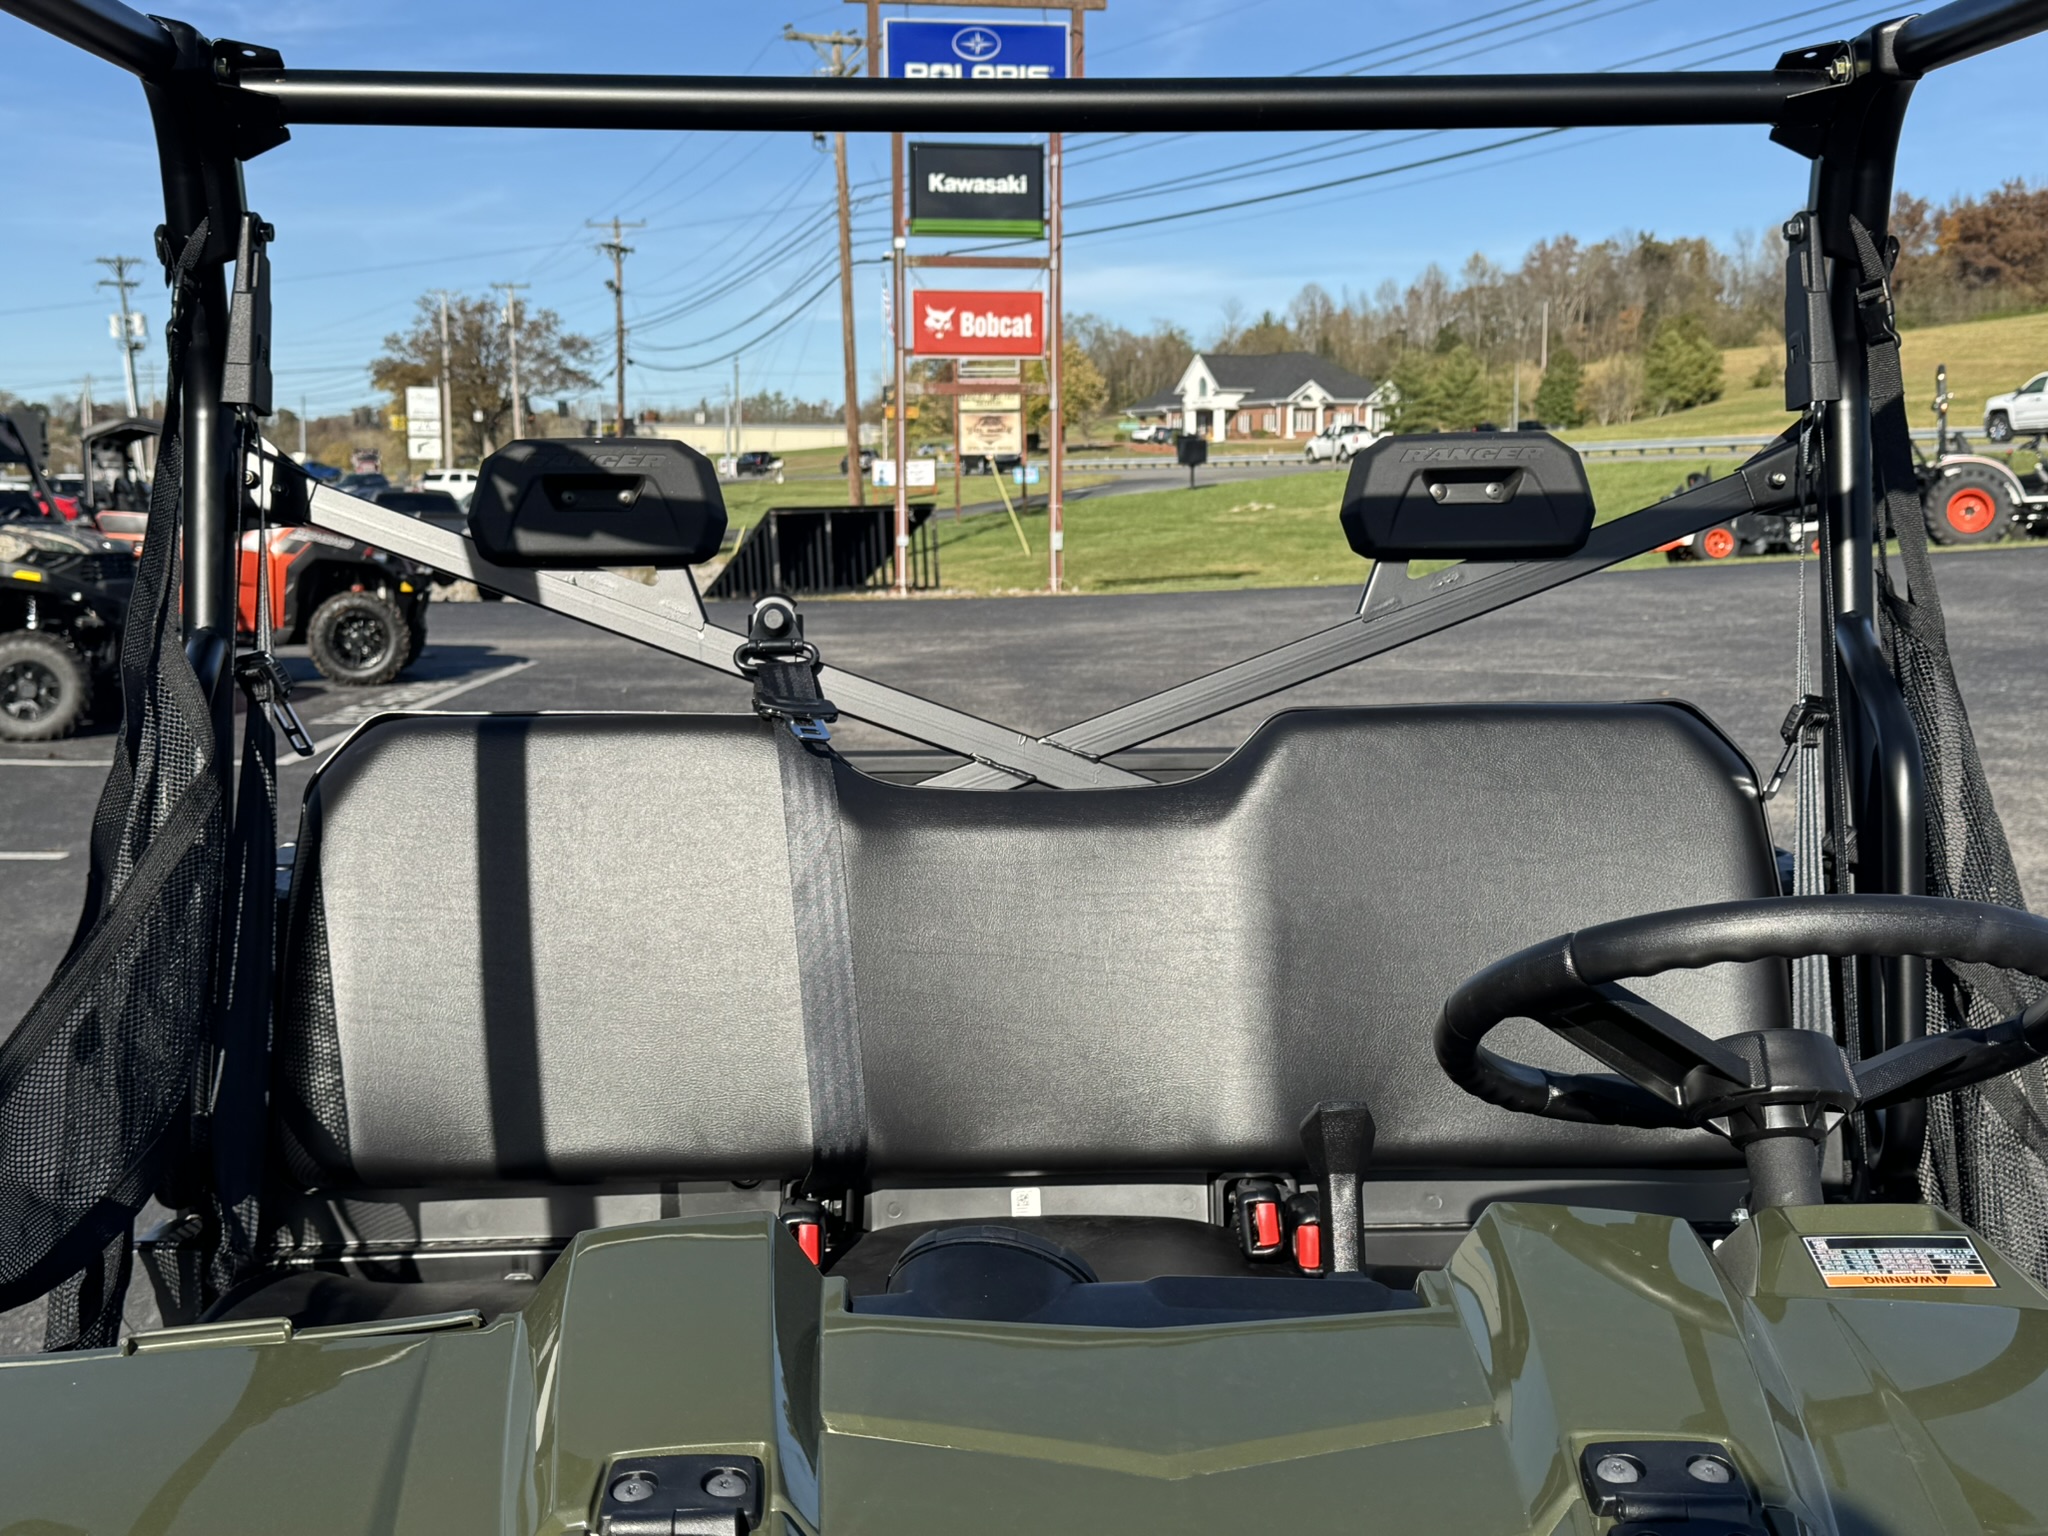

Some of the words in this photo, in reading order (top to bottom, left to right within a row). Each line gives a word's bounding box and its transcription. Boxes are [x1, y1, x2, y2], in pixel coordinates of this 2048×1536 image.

[928, 172, 1028, 194] Kawasaki
[960, 311, 1032, 338] Bobcat
[1400, 447, 1544, 462] RANGER
[1863, 1276, 1935, 1284] WARNING
